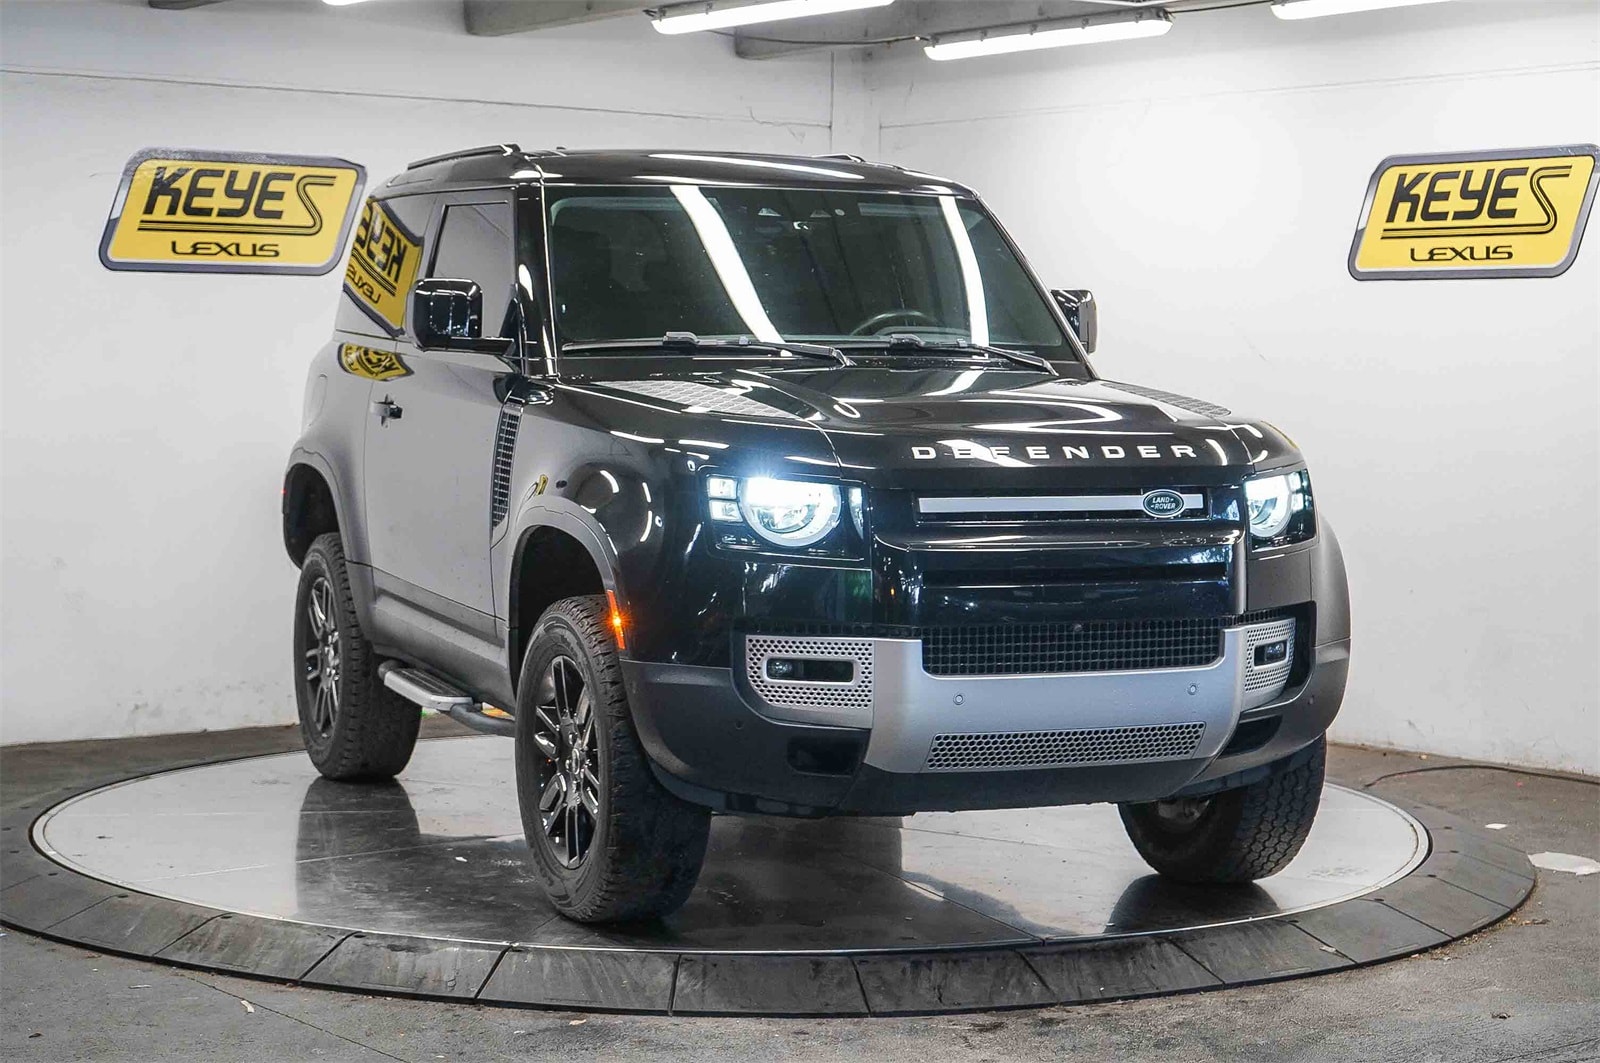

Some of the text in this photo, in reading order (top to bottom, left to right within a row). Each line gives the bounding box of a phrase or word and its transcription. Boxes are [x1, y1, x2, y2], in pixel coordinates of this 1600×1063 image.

[138, 166, 336, 236] KEYES
[1381, 165, 1572, 240] KEYES
[171, 241, 280, 257] LEXUS
[1410, 245, 1513, 262] LEXUS
[911, 445, 1197, 459] DEFENDER
